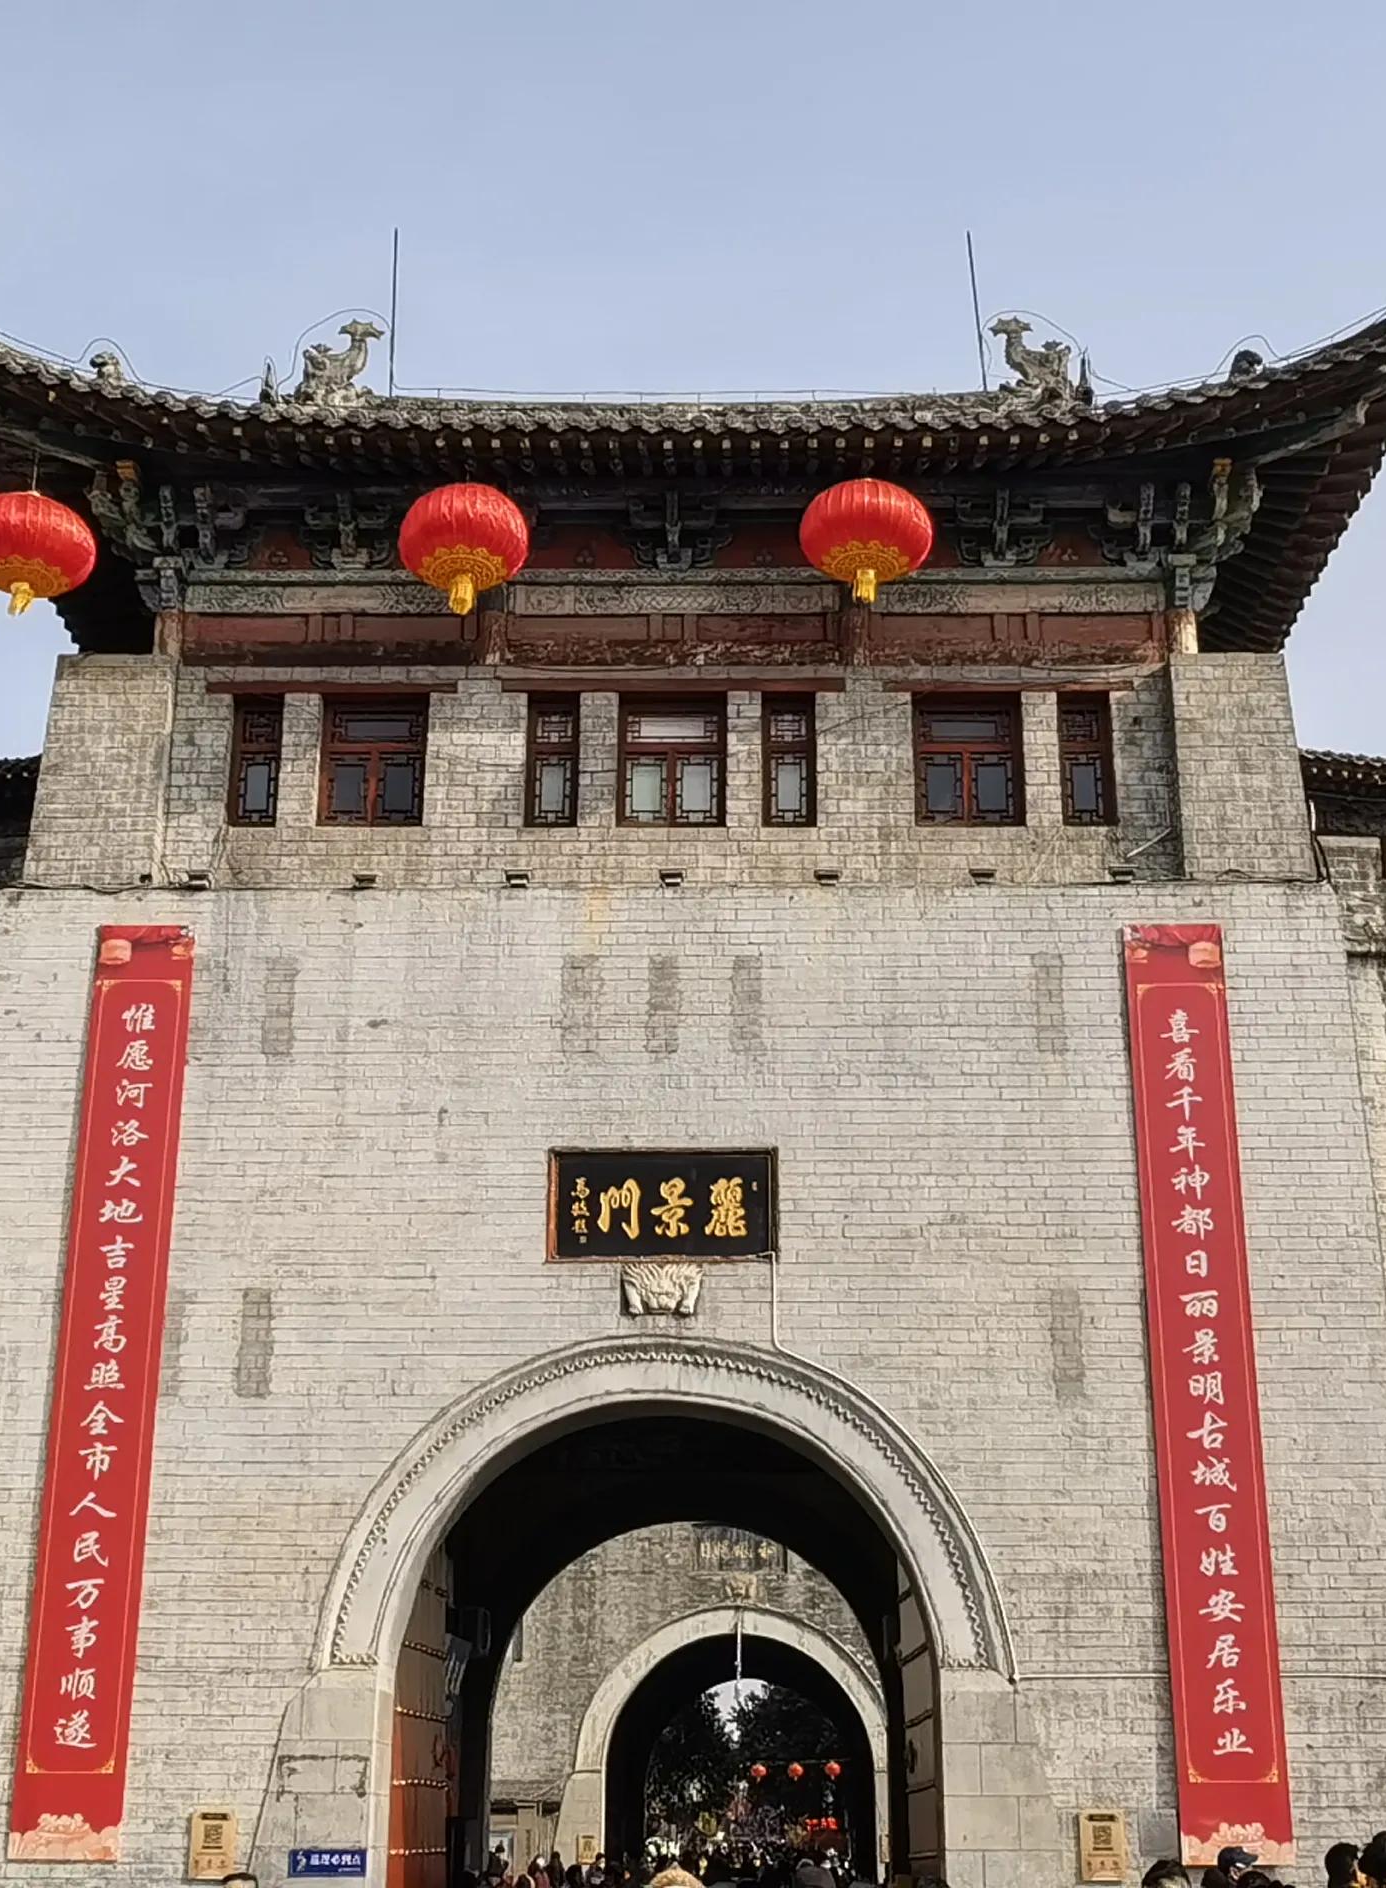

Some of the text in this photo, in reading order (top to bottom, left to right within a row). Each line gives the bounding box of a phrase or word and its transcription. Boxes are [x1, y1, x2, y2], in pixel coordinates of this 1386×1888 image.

[54, 1002, 156, 1749] 惟愿河洛大地吉星高照全市人民万事顺遂
[1159, 1008, 1254, 1757] 喜看千年神都日丽景明古城百姓安居乐业
